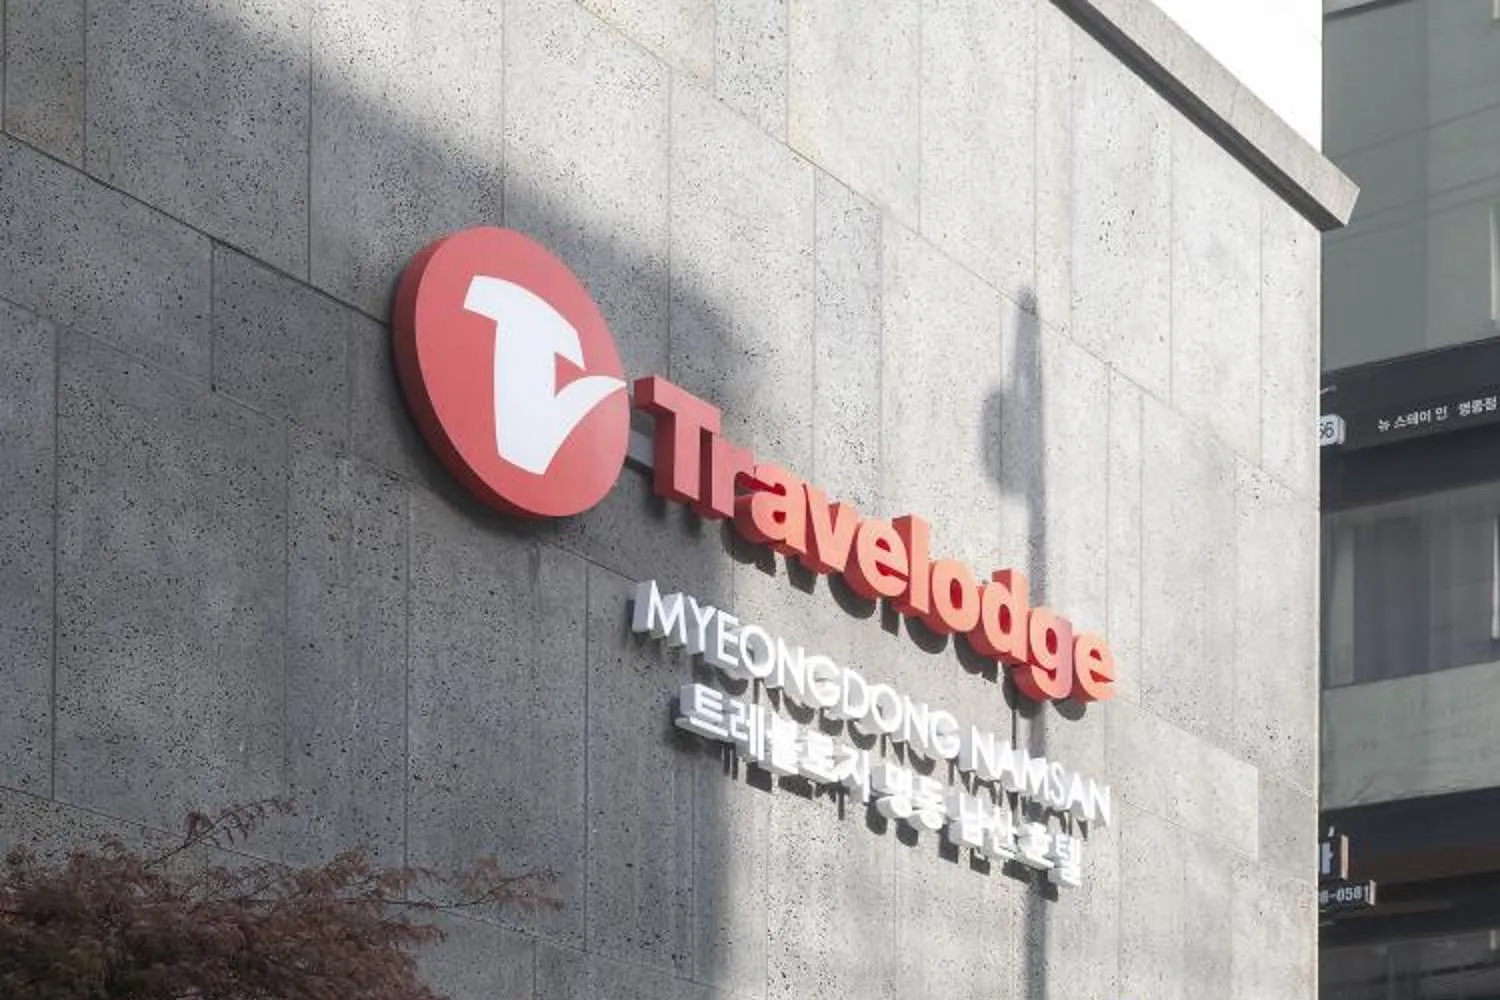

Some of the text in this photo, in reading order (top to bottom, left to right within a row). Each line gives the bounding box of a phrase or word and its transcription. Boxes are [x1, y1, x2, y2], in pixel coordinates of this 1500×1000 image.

[1435, 405, 1448, 421] 인
[634, 376, 1115, 701] Travelodge
[634, 580, 1111, 827] MYEONGDONG NAMSAN
